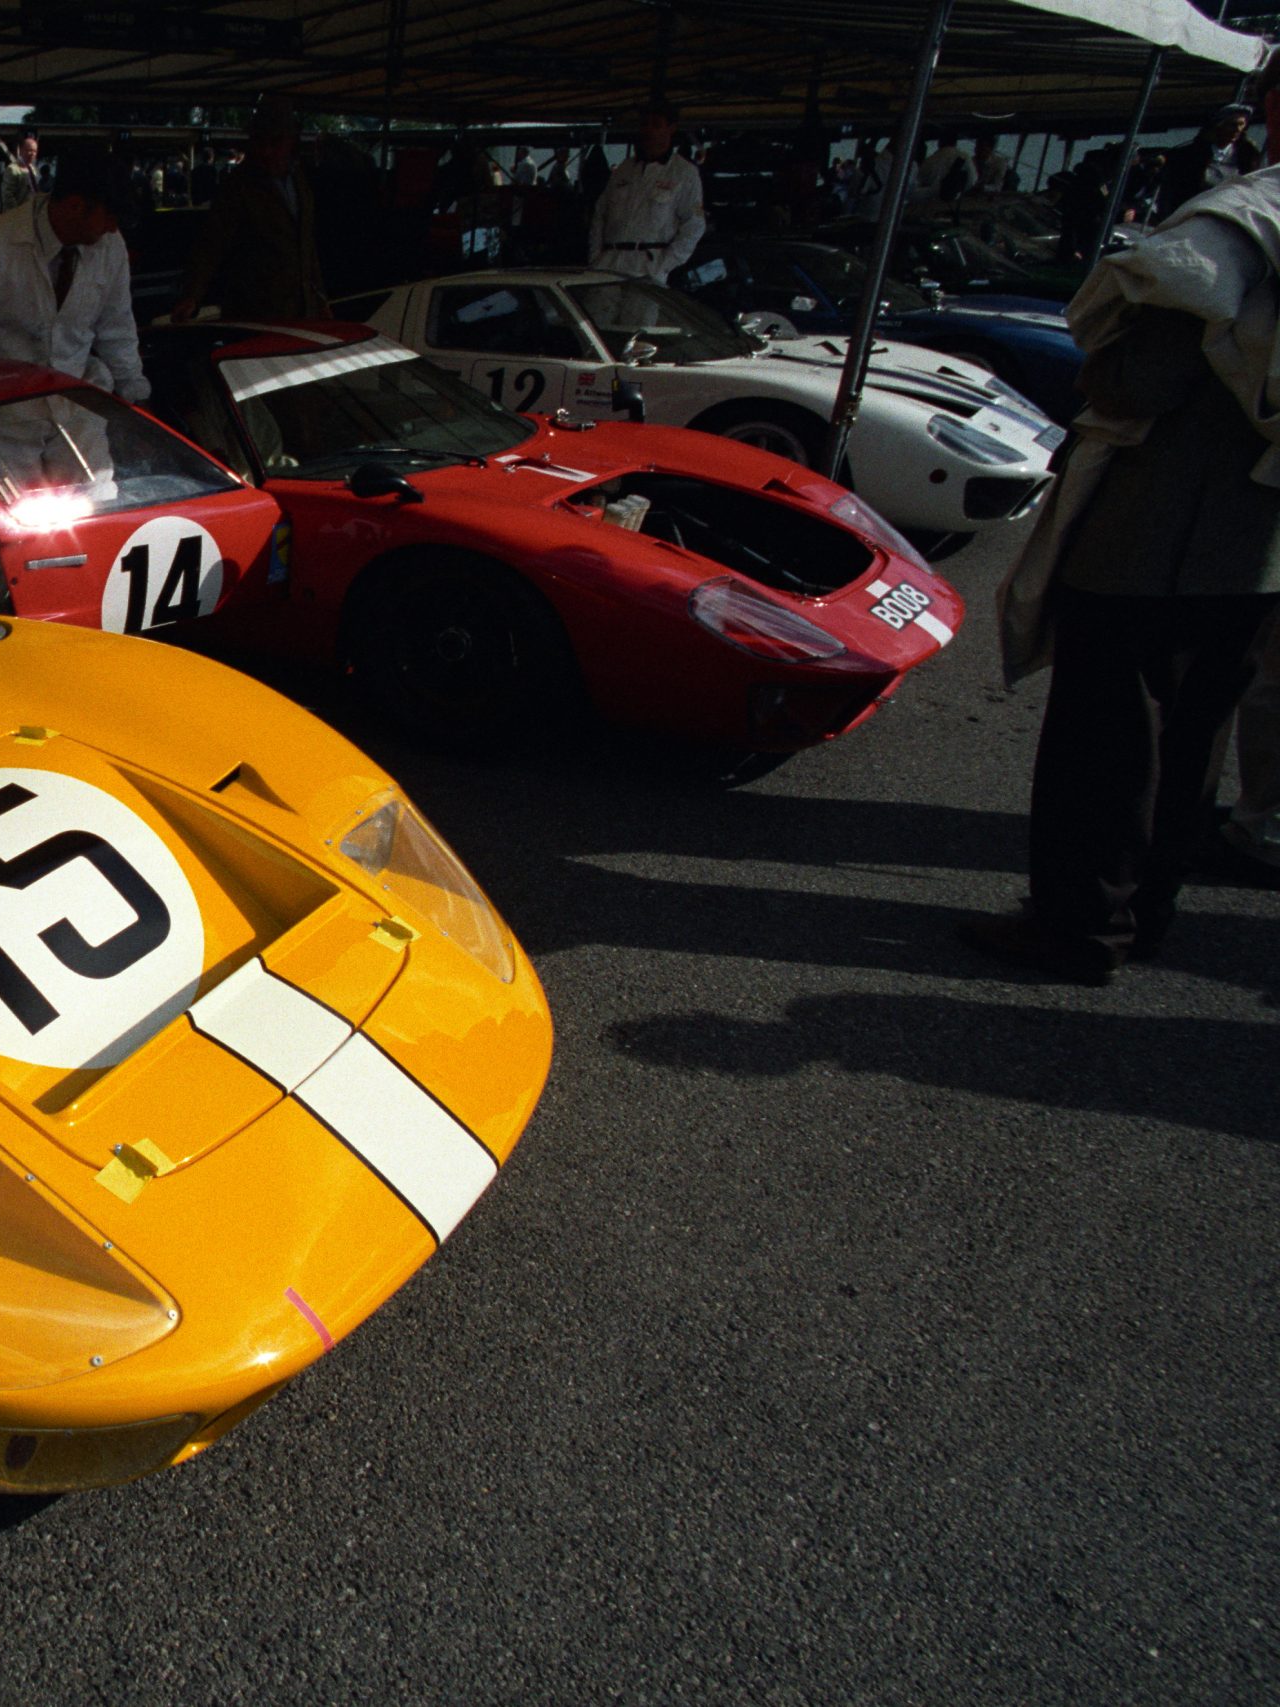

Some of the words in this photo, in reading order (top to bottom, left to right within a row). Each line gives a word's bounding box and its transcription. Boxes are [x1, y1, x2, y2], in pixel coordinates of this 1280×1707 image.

[486, 366, 546, 413] 12
[120, 534, 205, 635] 14
[869, 582, 932, 630] B008
